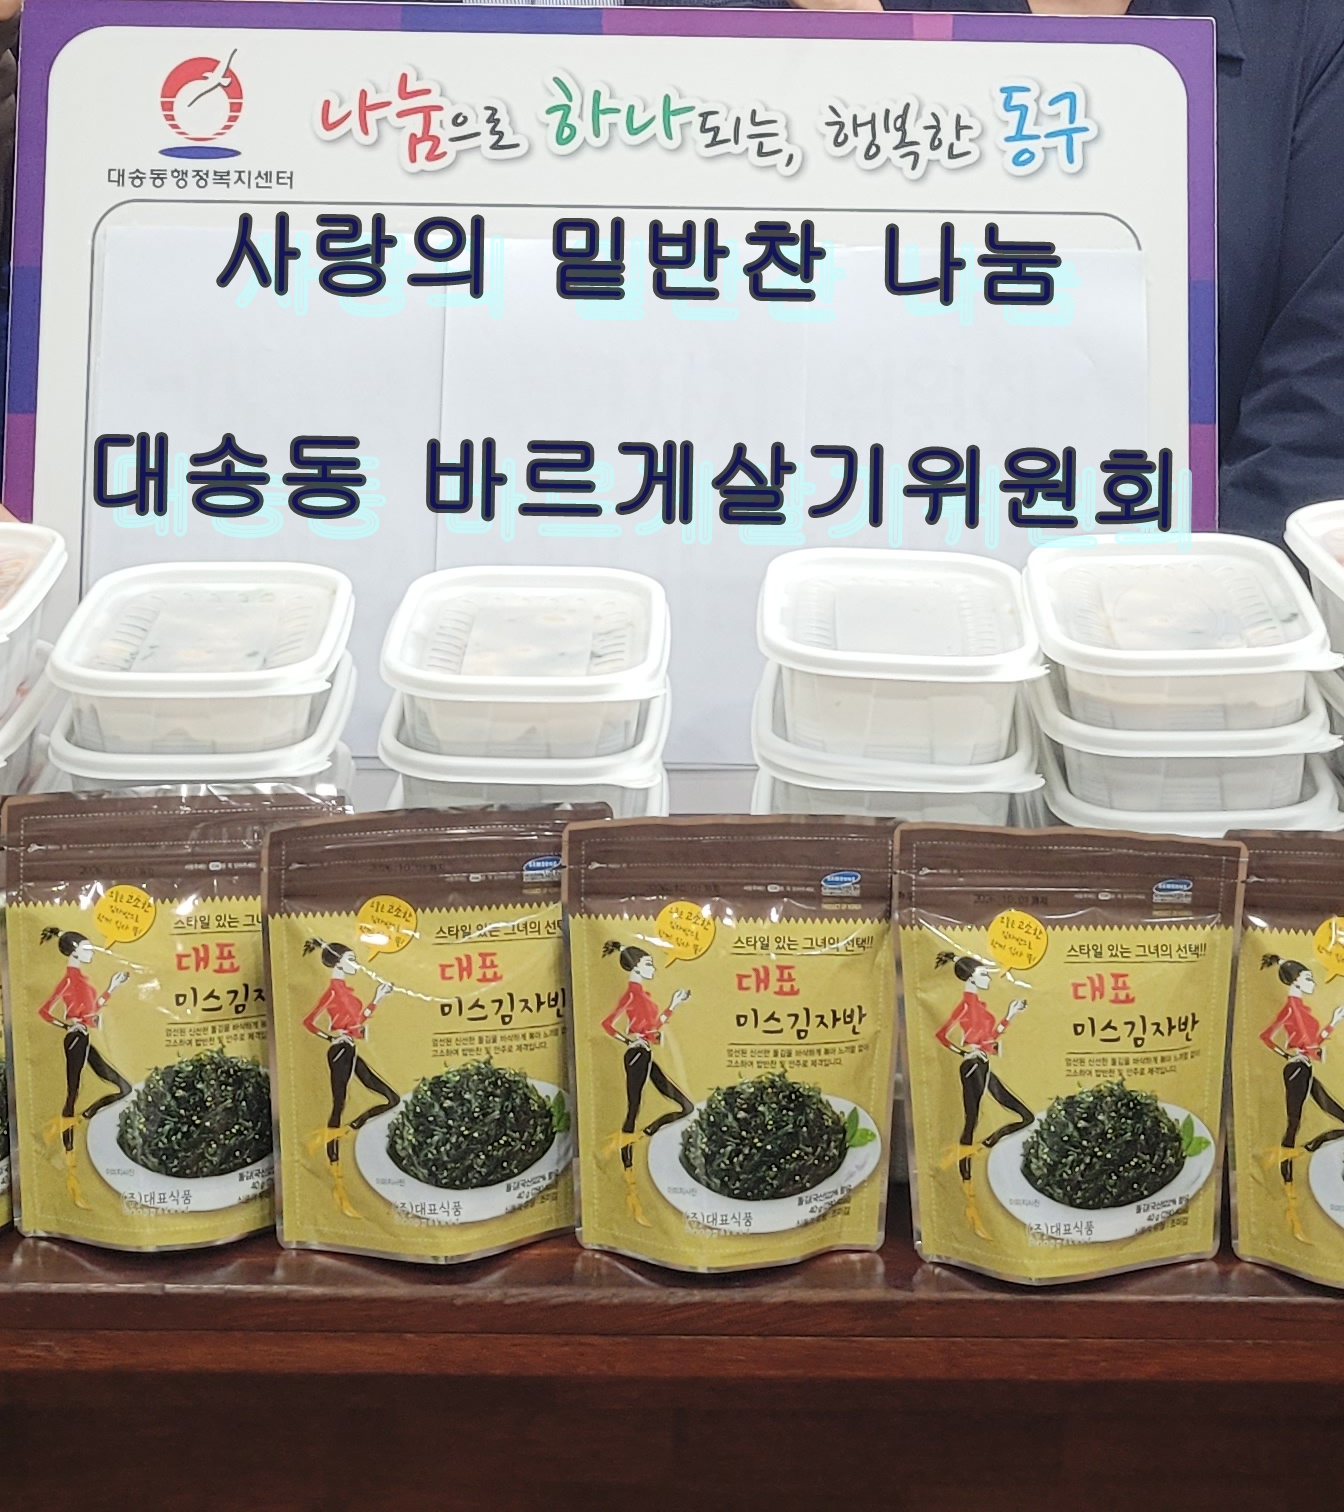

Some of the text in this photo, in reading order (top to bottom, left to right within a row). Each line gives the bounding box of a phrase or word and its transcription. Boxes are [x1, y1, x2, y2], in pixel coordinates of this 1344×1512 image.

[321, 73, 1090, 171] 나눔으로 하나되는, 행복한 동구
[107, 167, 294, 190] 대송동행정복지센터
[216, 211, 1063, 308] 사랑의 밑반찬 나눔
[92, 429, 1177, 534] 대송동 바르게살기위원회
[173, 914, 210, 930] 스타일
[215, 913, 239, 929] 있는
[436, 924, 472, 939] 스타일
[732, 936, 770, 951] 스타일
[774, 936, 798, 951] 있는
[801, 936, 839, 952] 그녀의
[1066, 942, 1207, 960] 스타일 있는 그녀의 선택!!
[175, 942, 240, 974] 대표
[438, 951, 504, 983] 대표
[735, 964, 800, 996] 대표
[1071, 972, 1136, 1005] 대표
[735, 1005, 867, 1040] 미스김자반
[1072, 1012, 1200, 1048] 미스김자반
[121, 1190, 193, 1207] (주)대표식품
[392, 1201, 463, 1217] (주)대표식품
[683, 1211, 754, 1228] (주)대표식품
[1026, 1220, 1095, 1236] (주)대표식품
